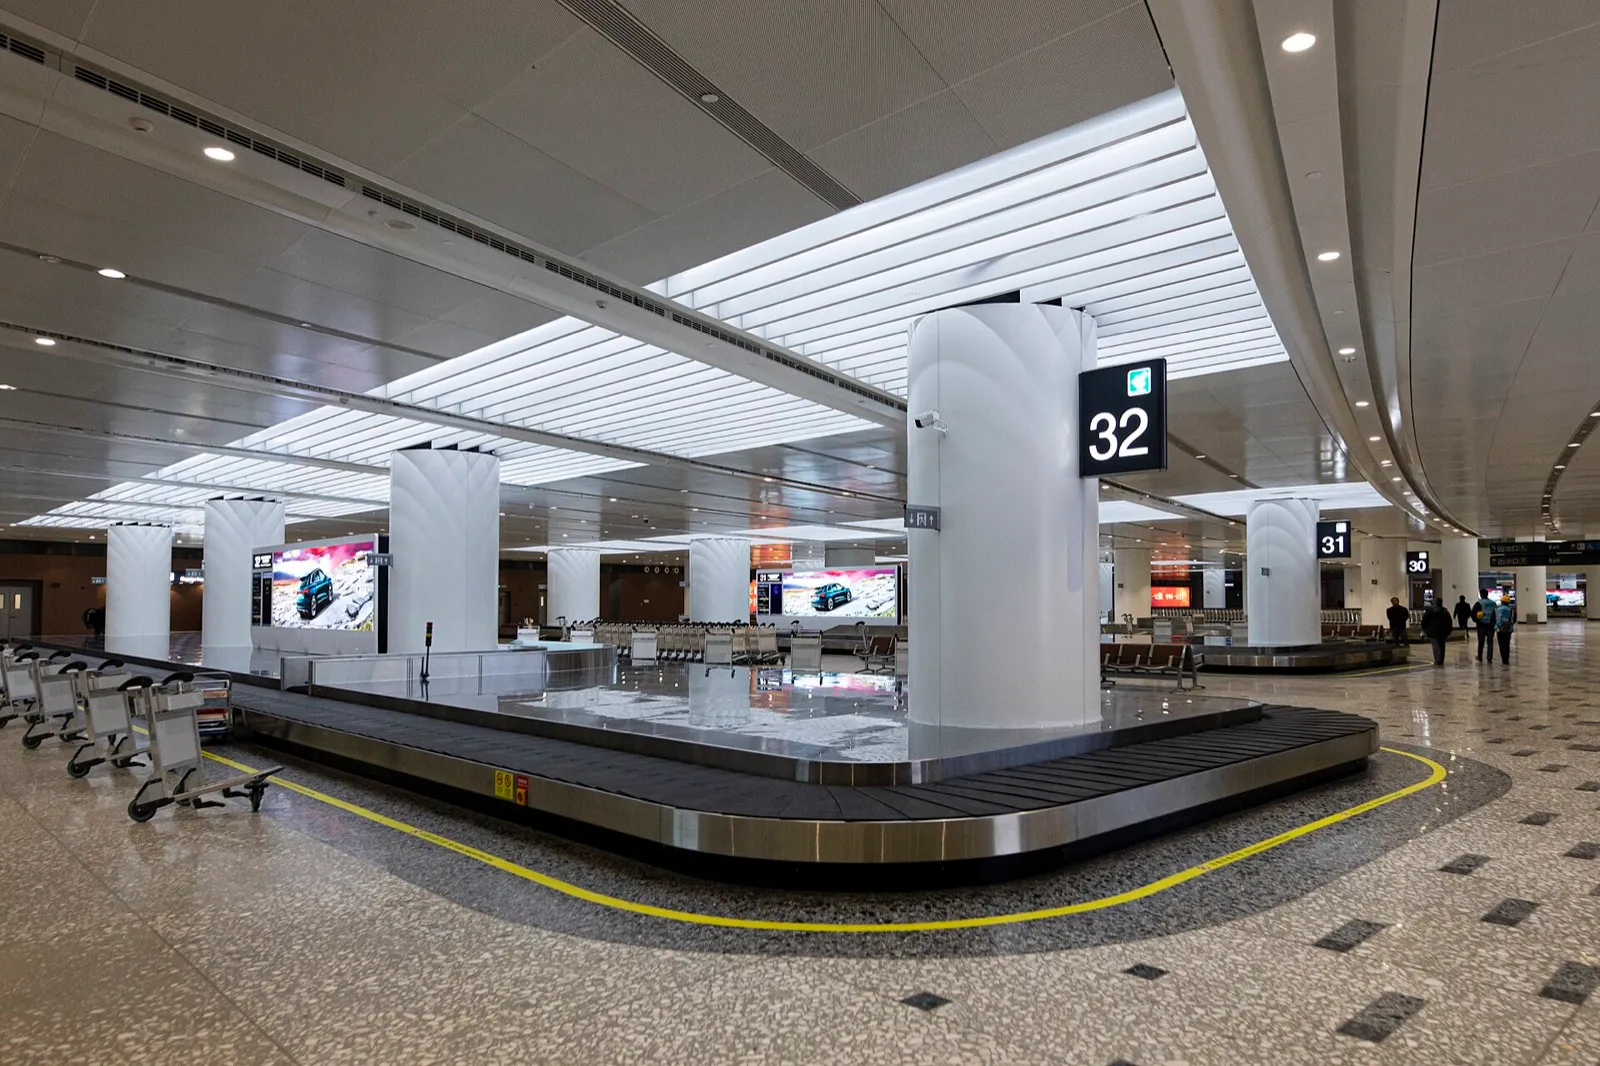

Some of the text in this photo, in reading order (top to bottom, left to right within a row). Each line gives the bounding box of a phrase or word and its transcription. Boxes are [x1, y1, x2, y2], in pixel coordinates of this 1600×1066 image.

[1088, 407, 1148, 461] 32
[1321, 535, 1344, 554] 31
[1408, 560, 1427, 572] 30
